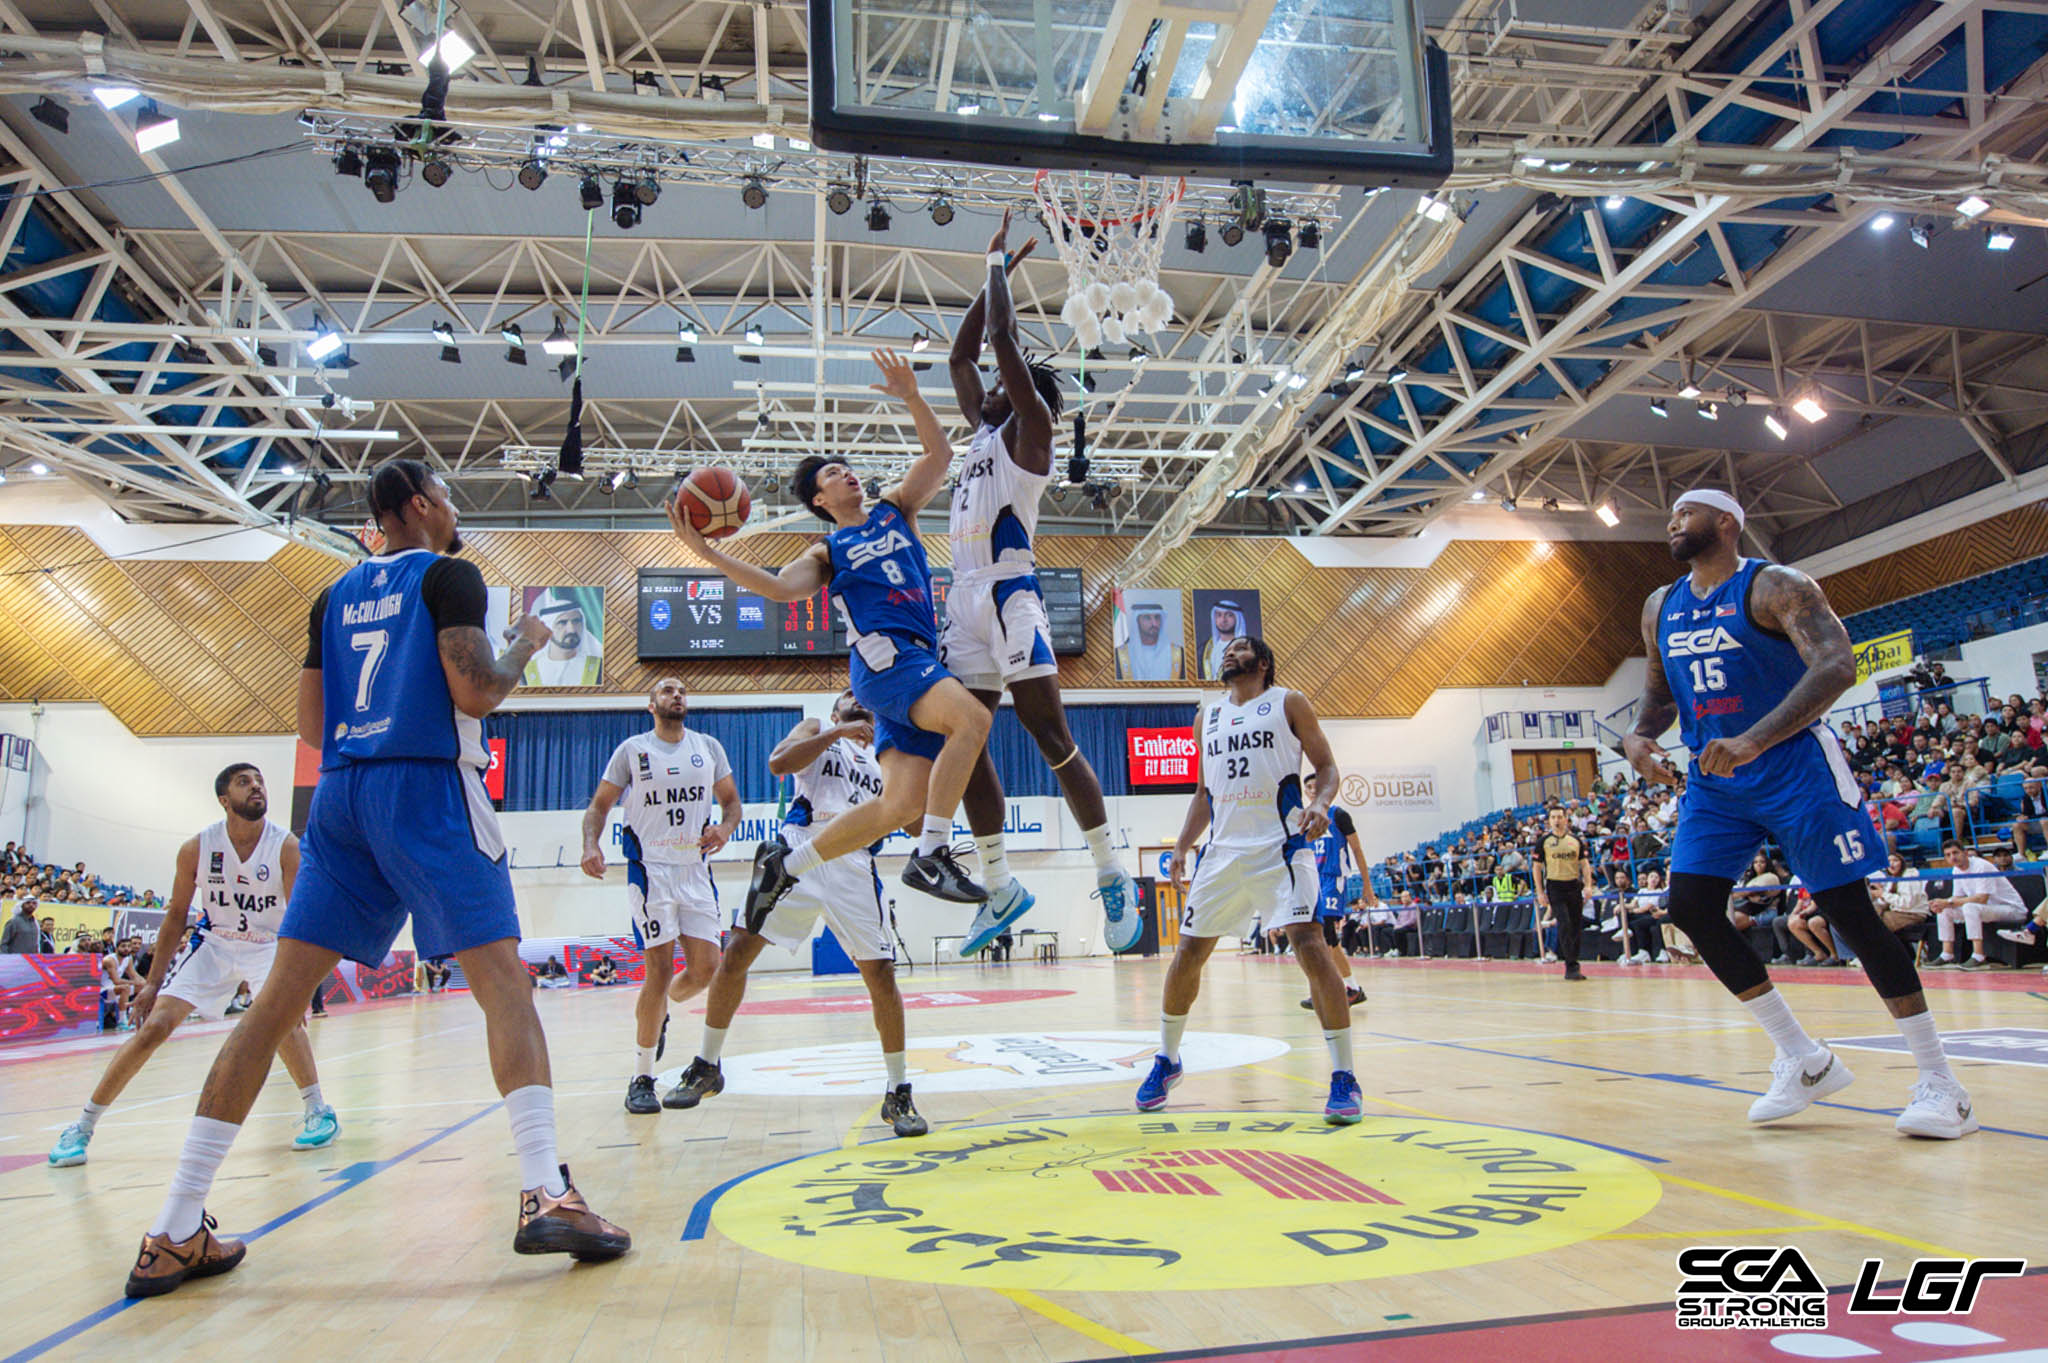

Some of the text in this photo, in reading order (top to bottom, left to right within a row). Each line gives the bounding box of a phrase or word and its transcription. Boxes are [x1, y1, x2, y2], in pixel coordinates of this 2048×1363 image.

[846, 529, 912, 570] SGA
[881, 559, 905, 585] 8
[688, 604, 722, 625] VS
[1667, 625, 1743, 658] SGA
[351, 630, 389, 712] 7
[1689, 657, 1728, 693] 15
[1133, 735, 1196, 758] Emirates
[1208, 731, 1274, 757] AL NASR
[822, 760, 843, 778] AL
[1145, 759, 1188, 776] FLY BETTER
[1227, 756, 1250, 780] 32
[644, 791, 661, 807] AL
[848, 792, 859, 805] 4
[1374, 781, 1434, 797] DUBAI
[666, 809, 685, 827] 19
[1314, 840, 1325, 854] 12
[1833, 829, 1865, 864] 15
[210, 891, 230, 906] AL
[1325, 897, 1338, 910] 12
[237, 913, 248, 932] 3
[643, 920, 660, 939] 19
[1138, 1120, 1588, 1257] DUBAI DUTY FREE
